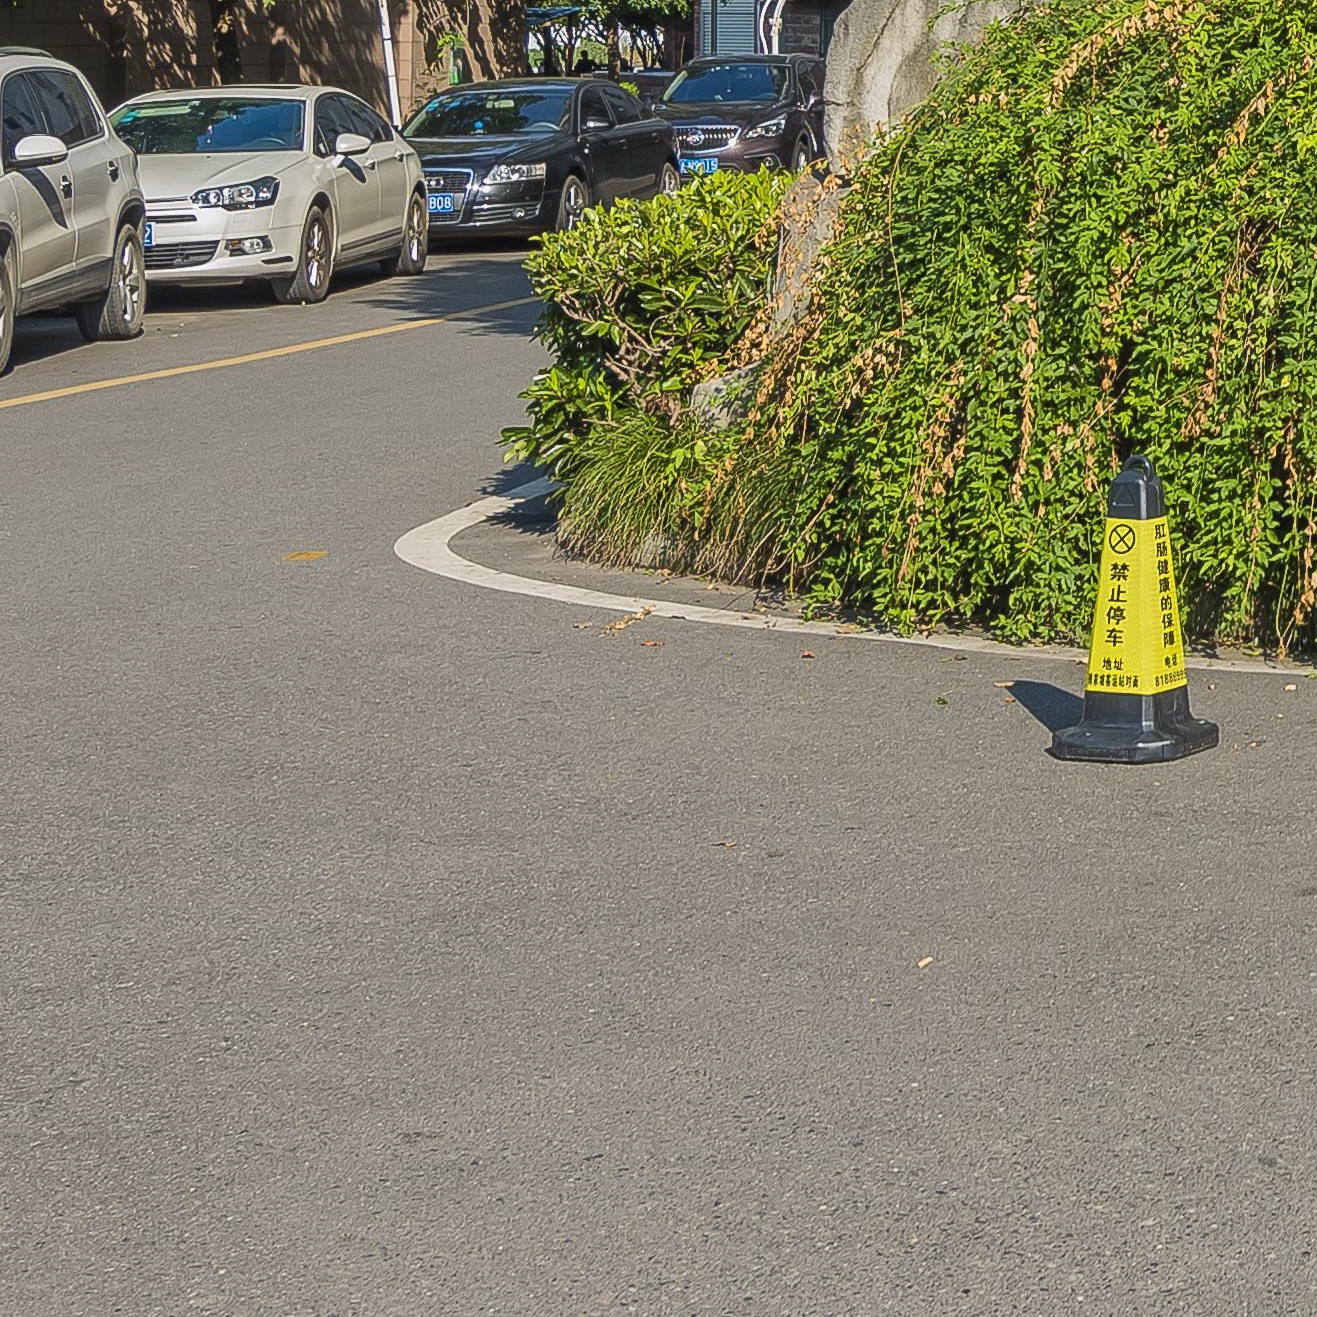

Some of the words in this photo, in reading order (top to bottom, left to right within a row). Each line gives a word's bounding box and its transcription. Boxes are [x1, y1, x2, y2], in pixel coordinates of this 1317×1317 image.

[428, 196, 452, 210] 808
[1104, 562, 1130, 647] 禁止停车
[1154, 524, 1175, 649] 肛肠健康的保障
[1102, 656, 1125, 671] 地址
